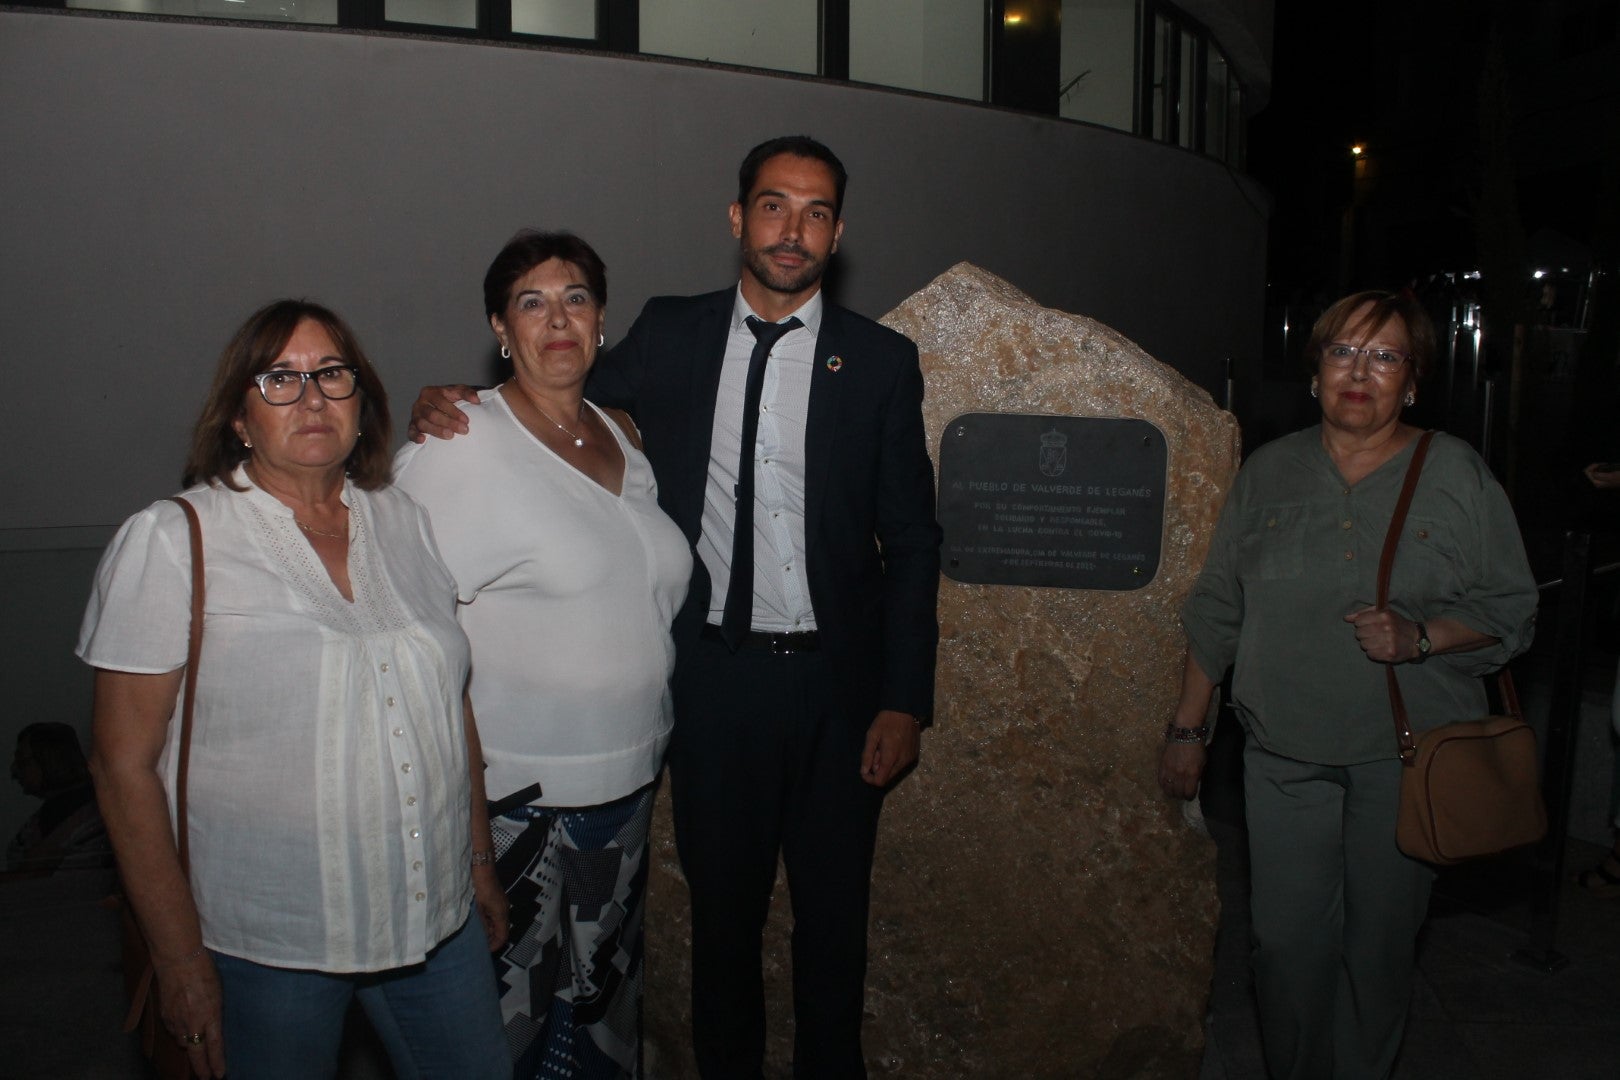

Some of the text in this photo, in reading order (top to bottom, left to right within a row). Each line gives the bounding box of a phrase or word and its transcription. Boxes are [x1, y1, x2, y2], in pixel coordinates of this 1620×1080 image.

[969, 481, 1008, 492] PUEBLO
[1013, 483, 1026, 493] DE
[1031, 483, 1082, 496] VALVERDE
[1087, 485, 1101, 495] DE
[1105, 485, 1152, 498] LEGANÉS
